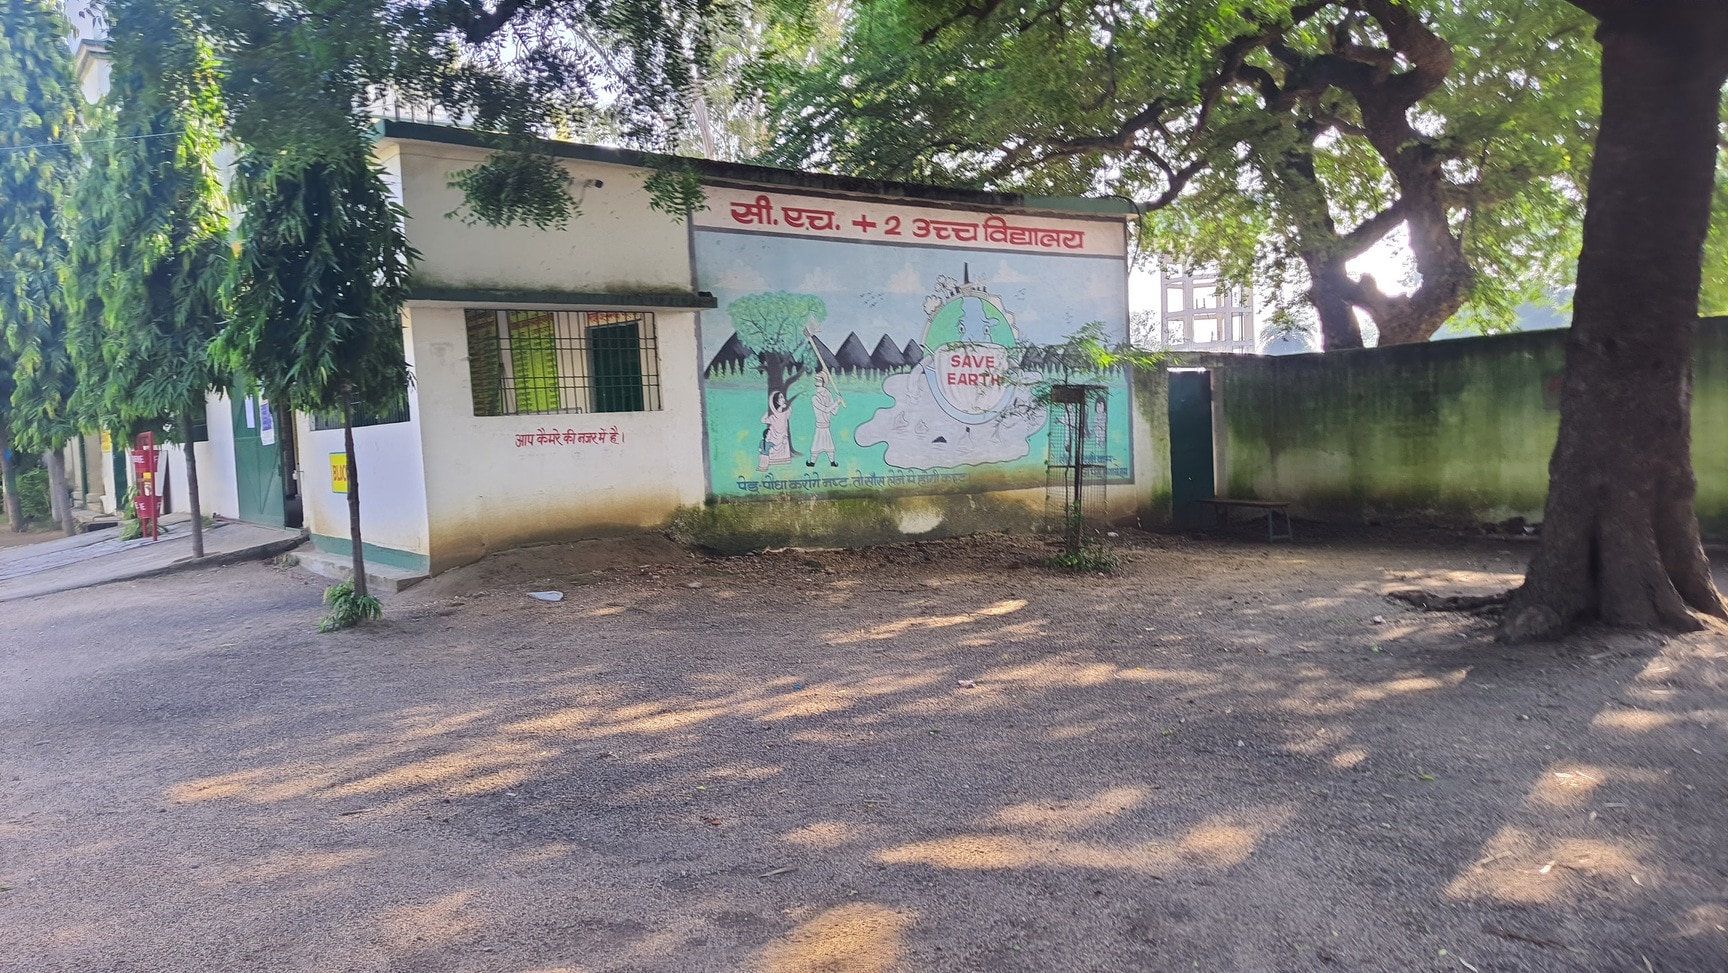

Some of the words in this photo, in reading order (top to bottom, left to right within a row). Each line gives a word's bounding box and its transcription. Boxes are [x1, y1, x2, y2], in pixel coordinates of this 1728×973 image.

[912, 218, 978, 242] उच्च
[983, 216, 1085, 249] विद्यालय
[951, 354, 995, 368] SAVE
[947, 373, 1001, 386] EARTH
[515, 434, 535, 448] आप
[536, 428, 563, 446] कैमरे
[562, 429, 576, 445] की
[789, 471, 821, 490] करोगे
